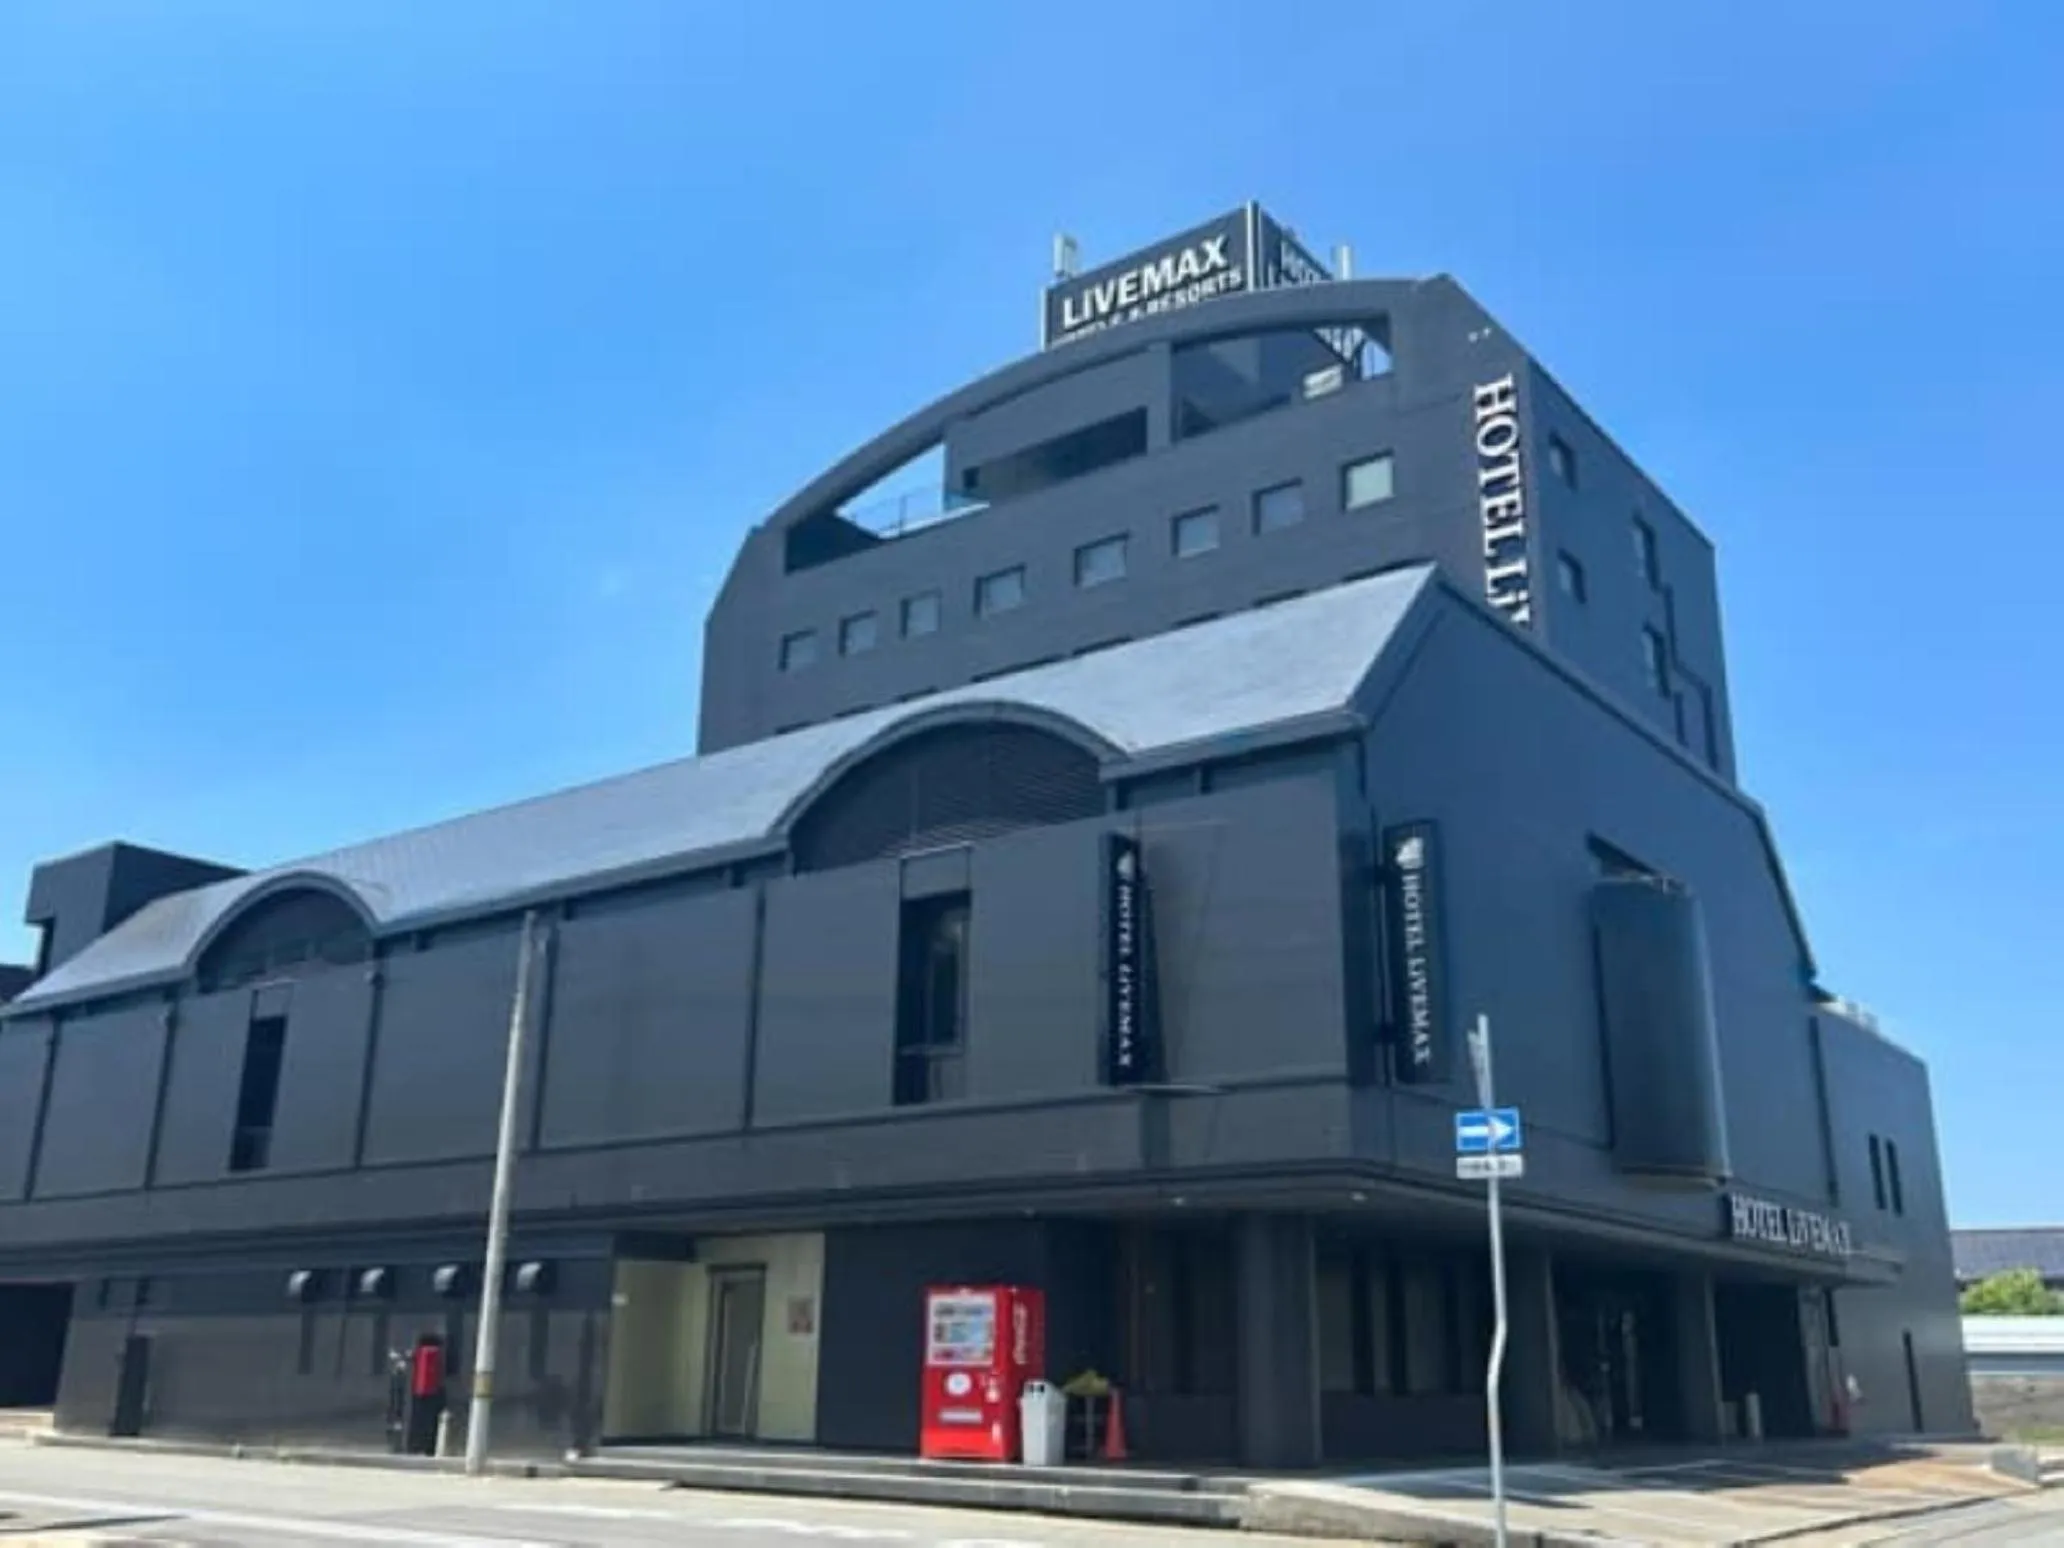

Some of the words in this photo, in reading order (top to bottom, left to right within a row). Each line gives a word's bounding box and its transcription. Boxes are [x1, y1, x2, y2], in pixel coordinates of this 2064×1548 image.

[1062, 234, 1229, 330] LIVEMAX
[1473, 372, 1526, 557] HOTEL
[1117, 885, 1134, 955] HOTEL
[1401, 873, 1426, 952] HOTEL
[1731, 1192, 1788, 1242] HOTEL
